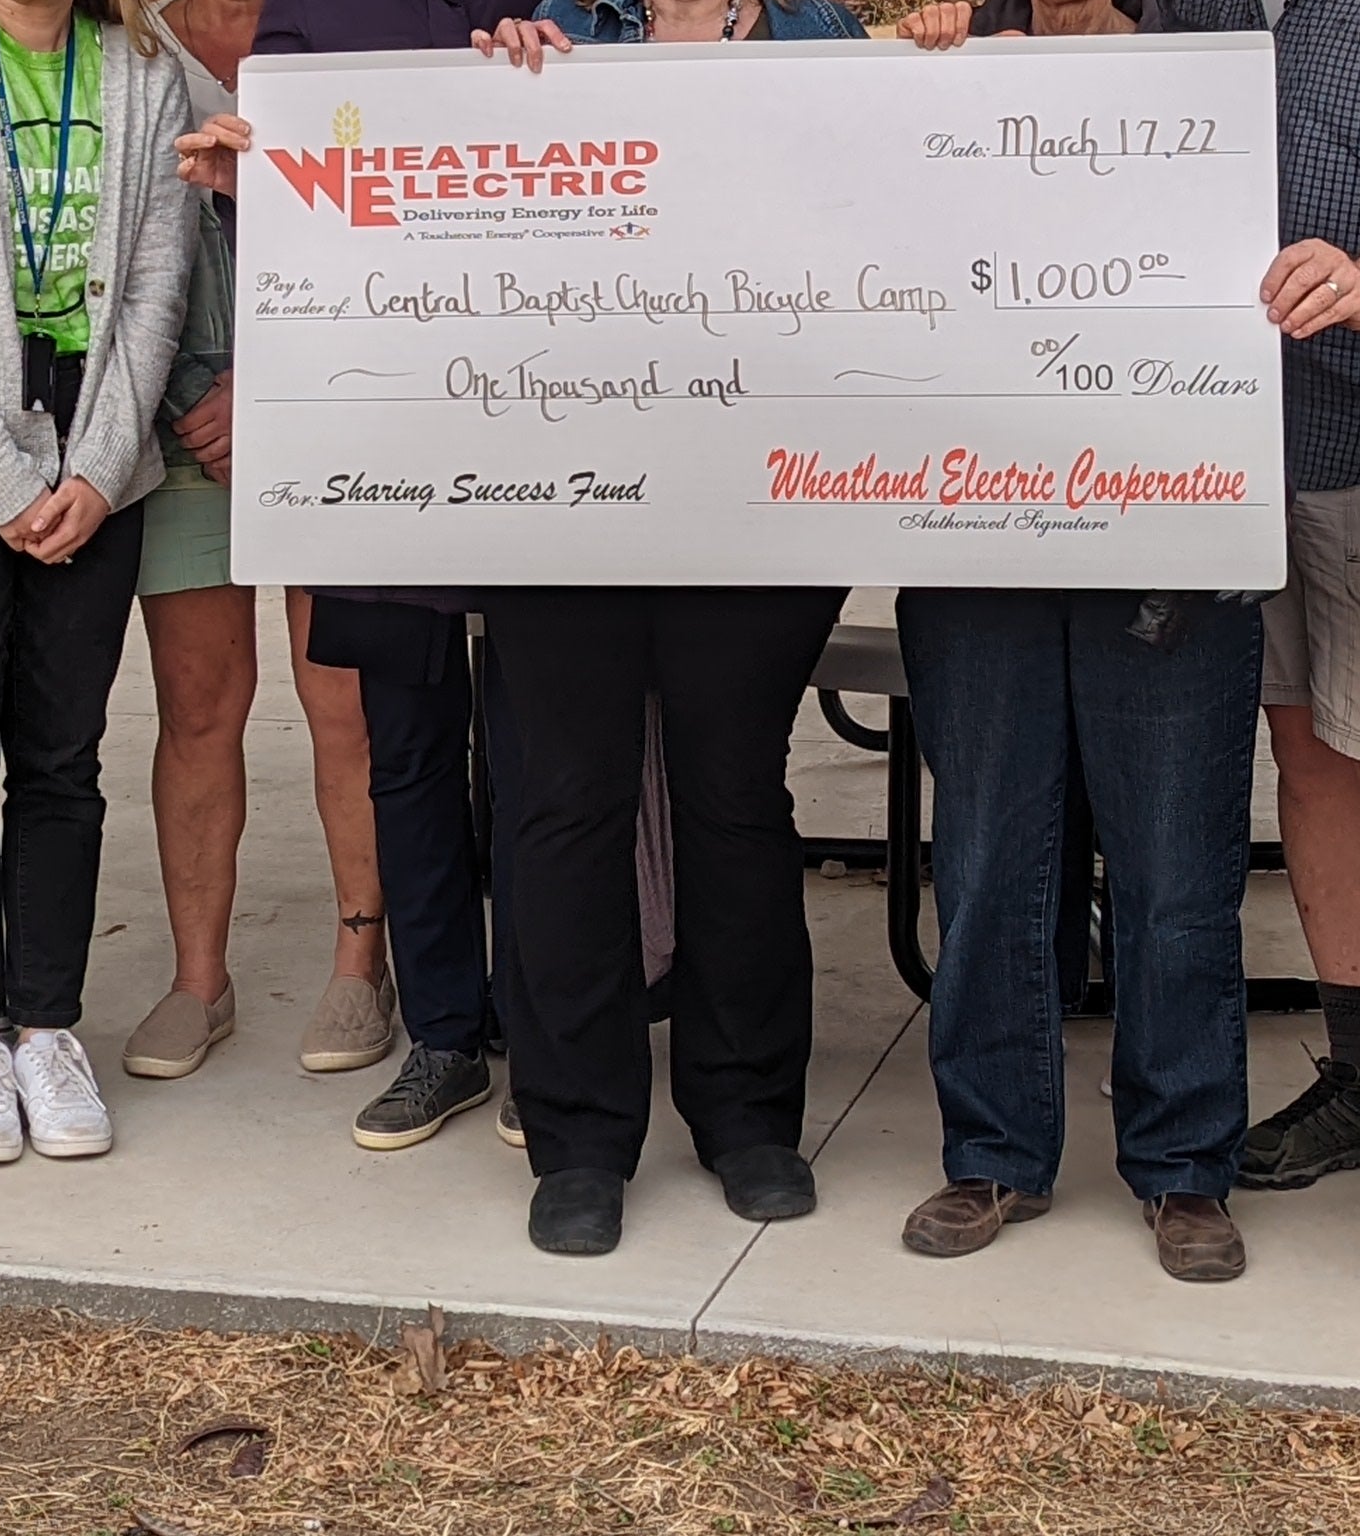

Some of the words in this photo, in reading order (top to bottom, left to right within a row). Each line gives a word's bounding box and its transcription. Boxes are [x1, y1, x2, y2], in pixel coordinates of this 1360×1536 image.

[923, 133, 990, 158] Date:
[997, 114, 1115, 175] March
[263, 141, 659, 214] WHEATLAND
[351, 170, 647, 226] ELECTRIC
[403, 209, 505, 222] Delivering
[512, 207, 582, 221] Energy
[587, 206, 616, 217] for
[621, 205, 659, 216] Life
[403, 232, 415, 241] A
[417, 231, 483, 240] Touchstone
[532, 228, 605, 239] Cooperative
[255, 272, 296, 298] Pay
[299, 277, 314, 292] to
[255, 298, 278, 314] the
[282, 300, 325, 314] order
[328, 296, 350, 321] of:
[365, 271, 481, 322] Central
[494, 272, 615, 326] Baptist
[615, 272, 727, 336] Church
[725, 269, 835, 336] Bicycle
[858, 264, 948, 331] Camp
[445, 356, 511, 417] One
[507, 349, 673, 422] Thousand
[688, 358, 749, 406] and
[1128, 357, 1260, 395] Dollars
[259, 481, 318, 507] For:
[321, 471, 436, 512] Sharing
[447, 473, 558, 504] Success
[568, 471, 647, 507] Fund
[766, 448, 930, 502] Wheatland
[940, 448, 1055, 505] Electric
[1066, 447, 1247, 515] Cooperative
[899, 509, 1011, 532] Authorized
[1014, 509, 1109, 538] Signature
